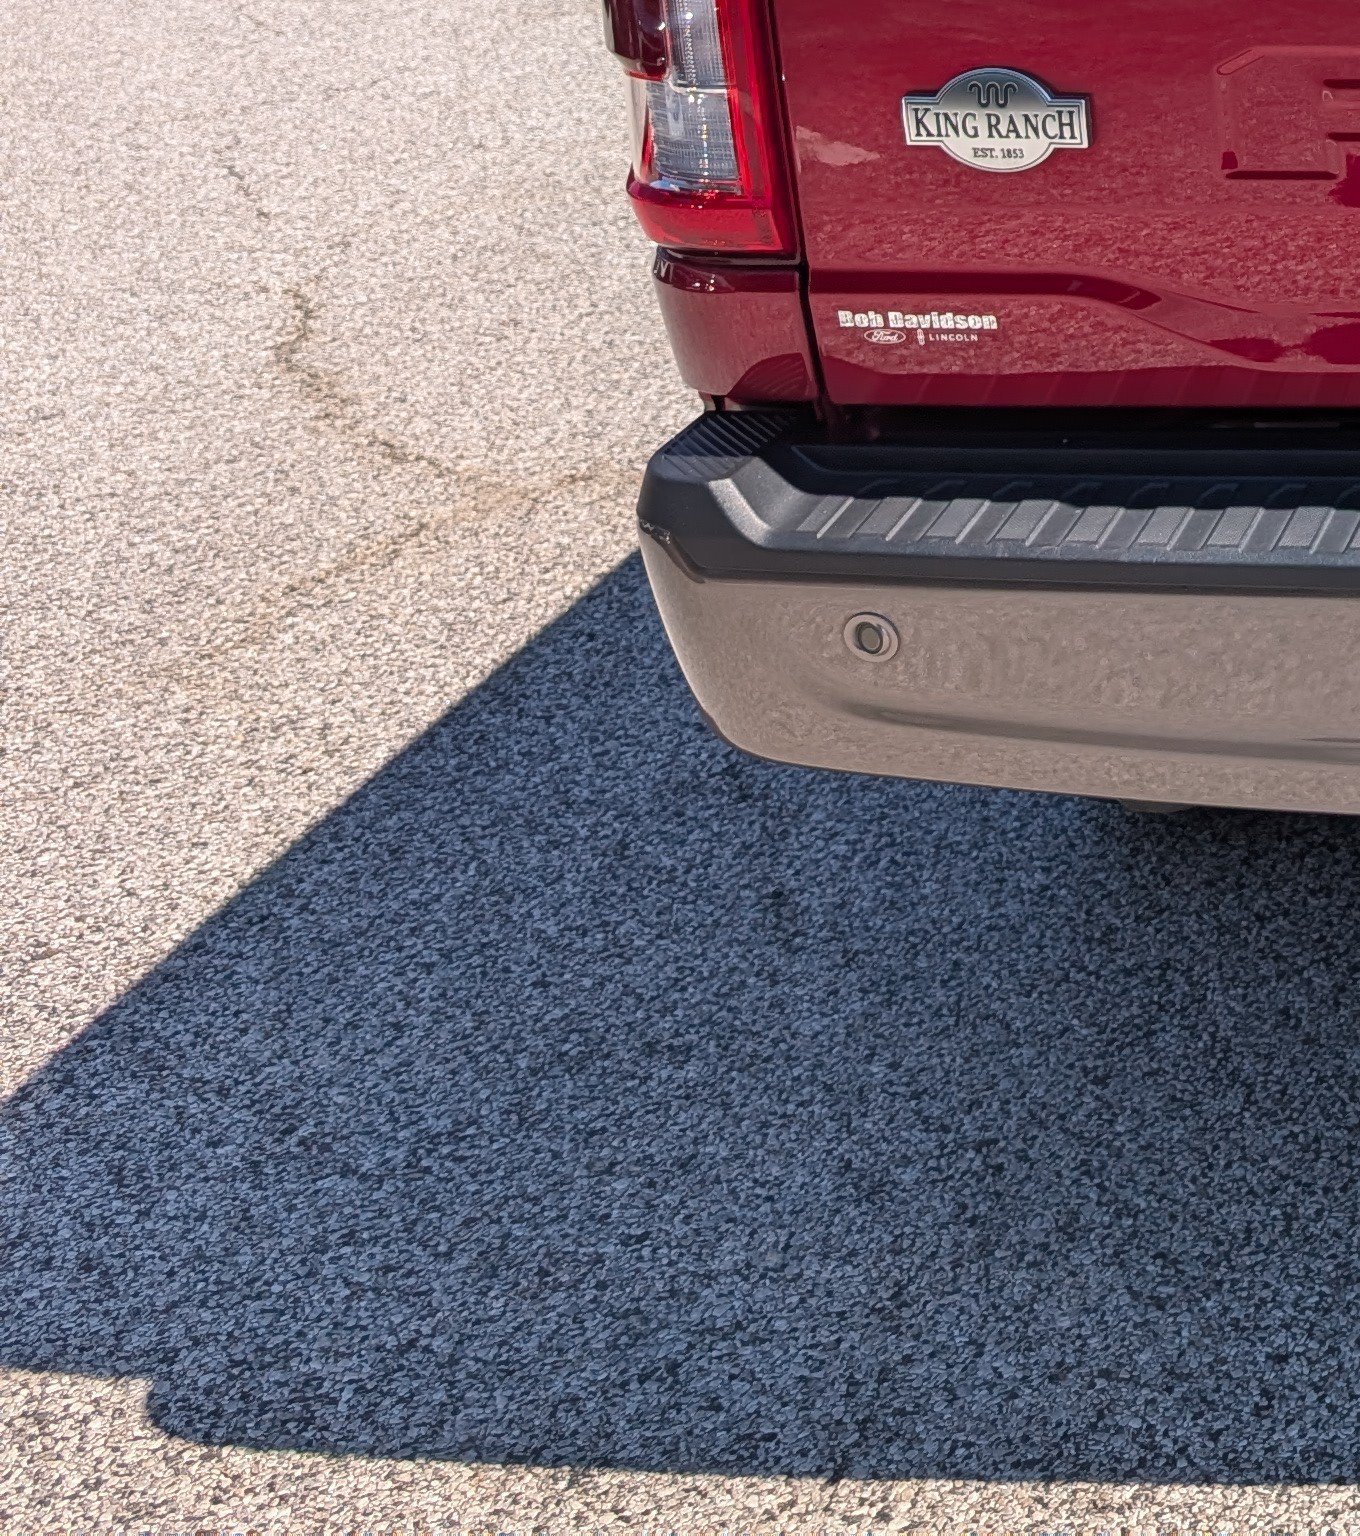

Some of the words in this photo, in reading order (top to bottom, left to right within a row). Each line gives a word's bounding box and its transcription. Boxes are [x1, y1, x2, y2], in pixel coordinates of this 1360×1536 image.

[912, 107, 980, 139] KING
[986, 109, 1078, 141] RANCH
[972, 147, 999, 159] EST.
[1000, 148, 1025, 159] 1853
[837, 310, 885, 329] Bob
[888, 311, 999, 331] Davidson
[928, 332, 979, 342] LINCOLN
